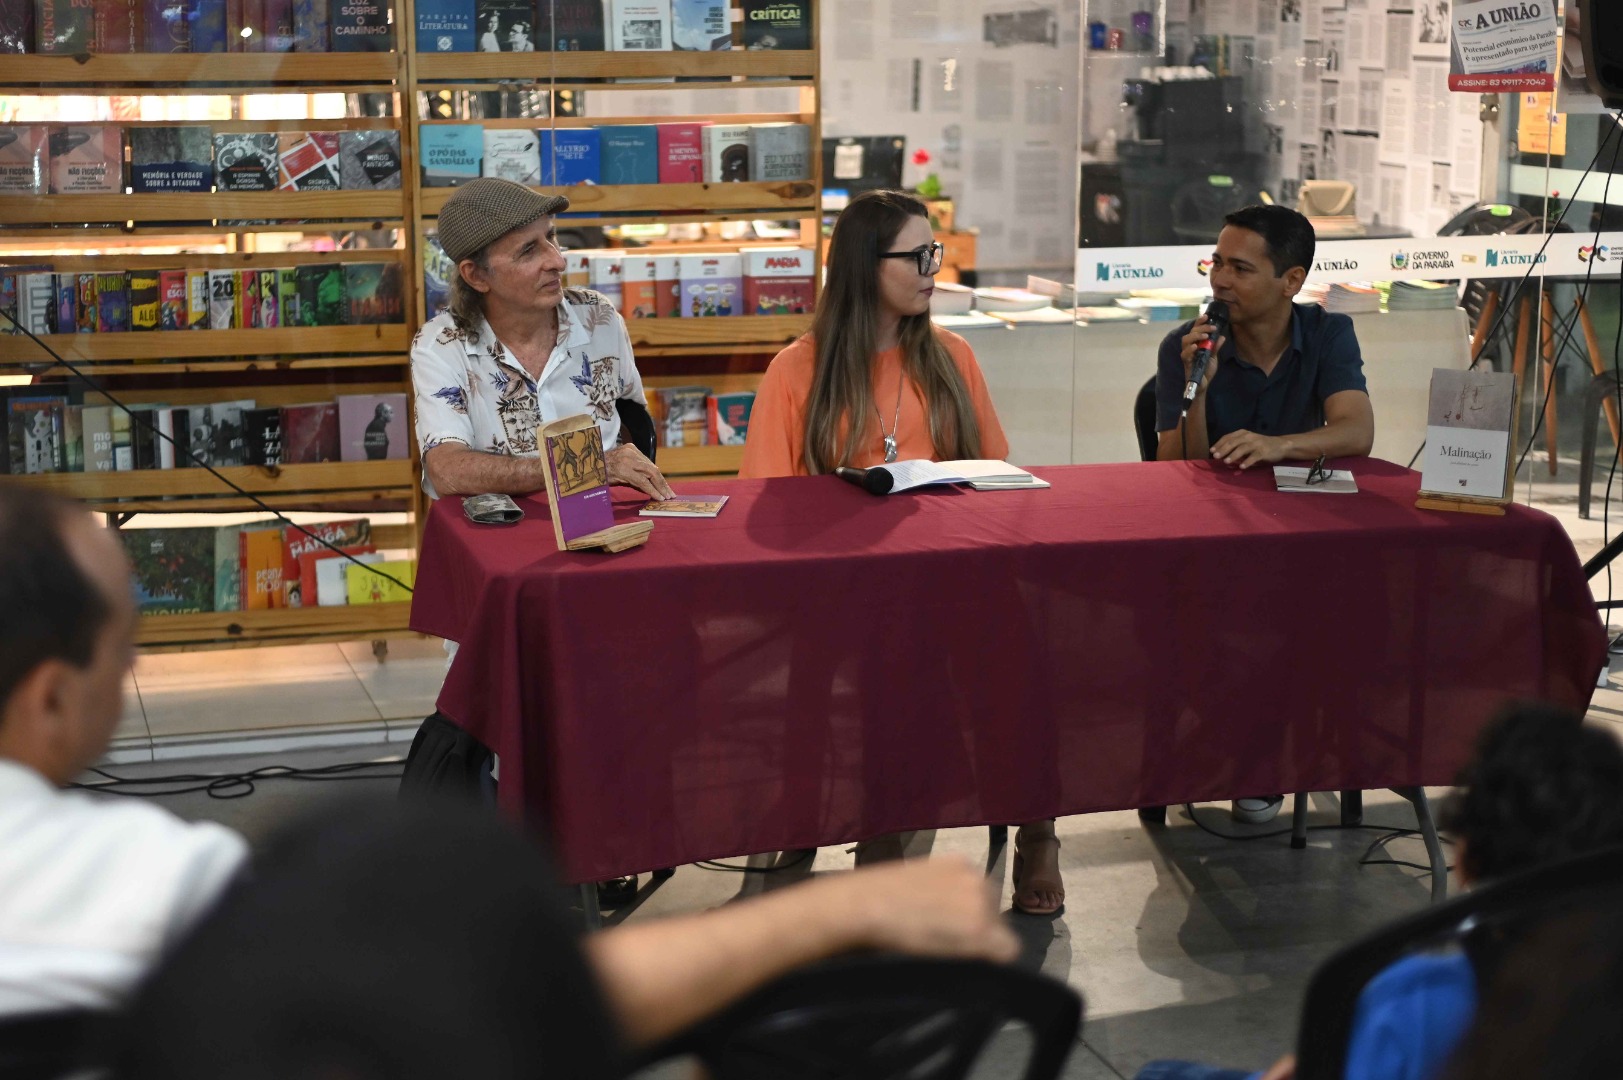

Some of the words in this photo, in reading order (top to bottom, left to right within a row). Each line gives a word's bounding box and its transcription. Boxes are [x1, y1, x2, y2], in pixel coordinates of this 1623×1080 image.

[341, 6, 378, 15] SOBRE
[750, 8, 801, 20] CRÍTICA!
[1476, 13, 1490, 29] A
[1489, 2, 1541, 25] UNIÃO
[356, 16, 365, 25] O
[419, 21, 469, 30] LITERATURA
[335, 25, 387, 35] CAMINHO
[1463, 43, 1496, 54] Potencial
[1496, 37, 1528, 49] econômico
[1528, 33, 1536, 42] da
[1471, 48, 1514, 62] apresentado
[1514, 45, 1528, 55] para
[1539, 39, 1556, 50] países
[1457, 79, 1488, 87] ASSINE:
[1501, 78, 1546, 86] 99117-7042
[429, 157, 475, 166] SANDÁLIAS
[142, 171, 169, 179] MEMÓRIA
[146, 179, 164, 187] SOBRE
[172, 178, 200, 187] DITADURA
[1412, 251, 1449, 261] GOVERNO
[1501, 255, 1509, 264] A
[1510, 253, 1547, 265] UNIÃO
[1315, 261, 1322, 271] A
[1324, 259, 1358, 271] UNIÃO
[1412, 261, 1423, 270] DA
[1424, 259, 1454, 270] PARAÍBA
[1112, 269, 1120, 279] A
[1122, 266, 1164, 279] UNIÃO
[1440, 445, 1492, 461] Malinação
